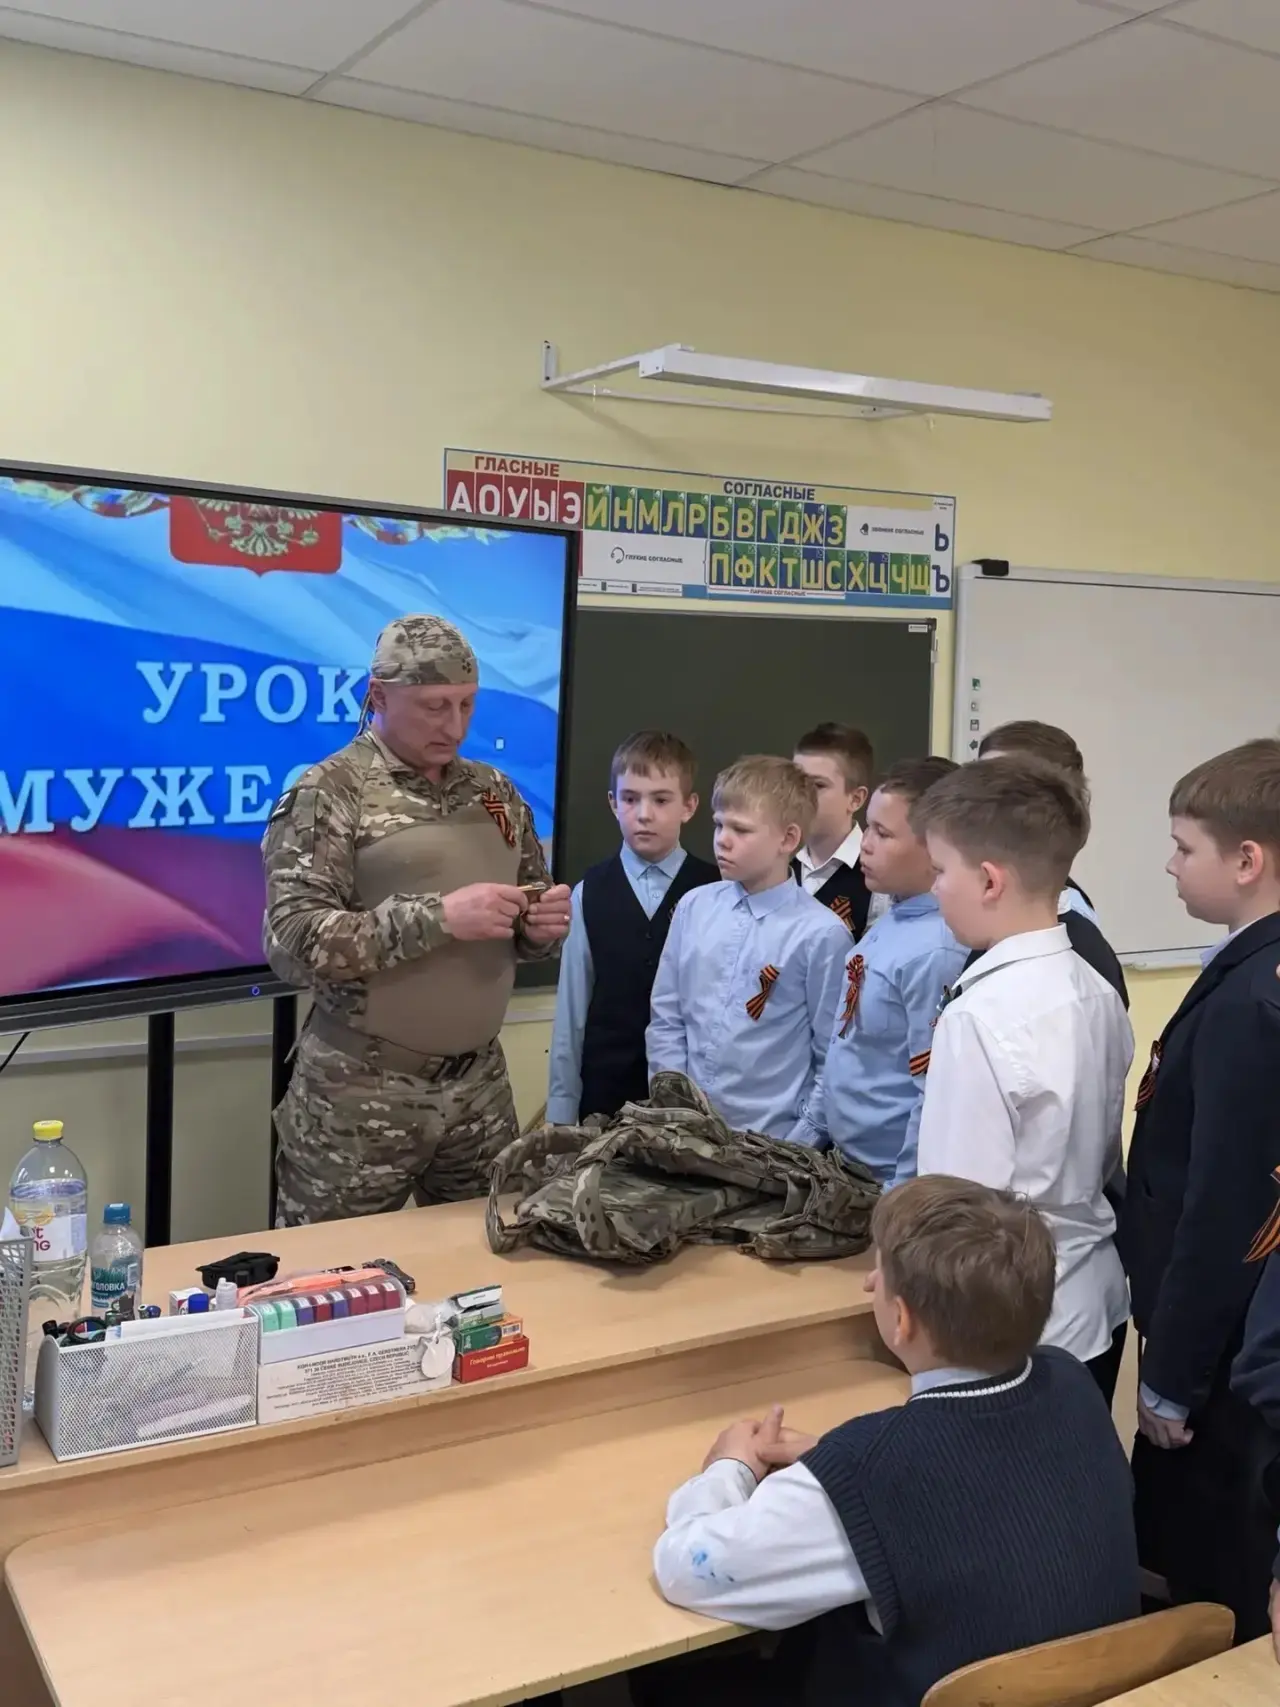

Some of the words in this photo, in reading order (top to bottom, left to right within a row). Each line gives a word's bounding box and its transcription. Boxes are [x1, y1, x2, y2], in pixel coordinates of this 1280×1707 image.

[474, 456, 560, 477] ГЛАСНЫЕ
[723, 480, 815, 501] СОГЛАСНЫЕ
[136, 661, 368, 724] УРОК
[0, 764, 314, 834] МУЖЕ
